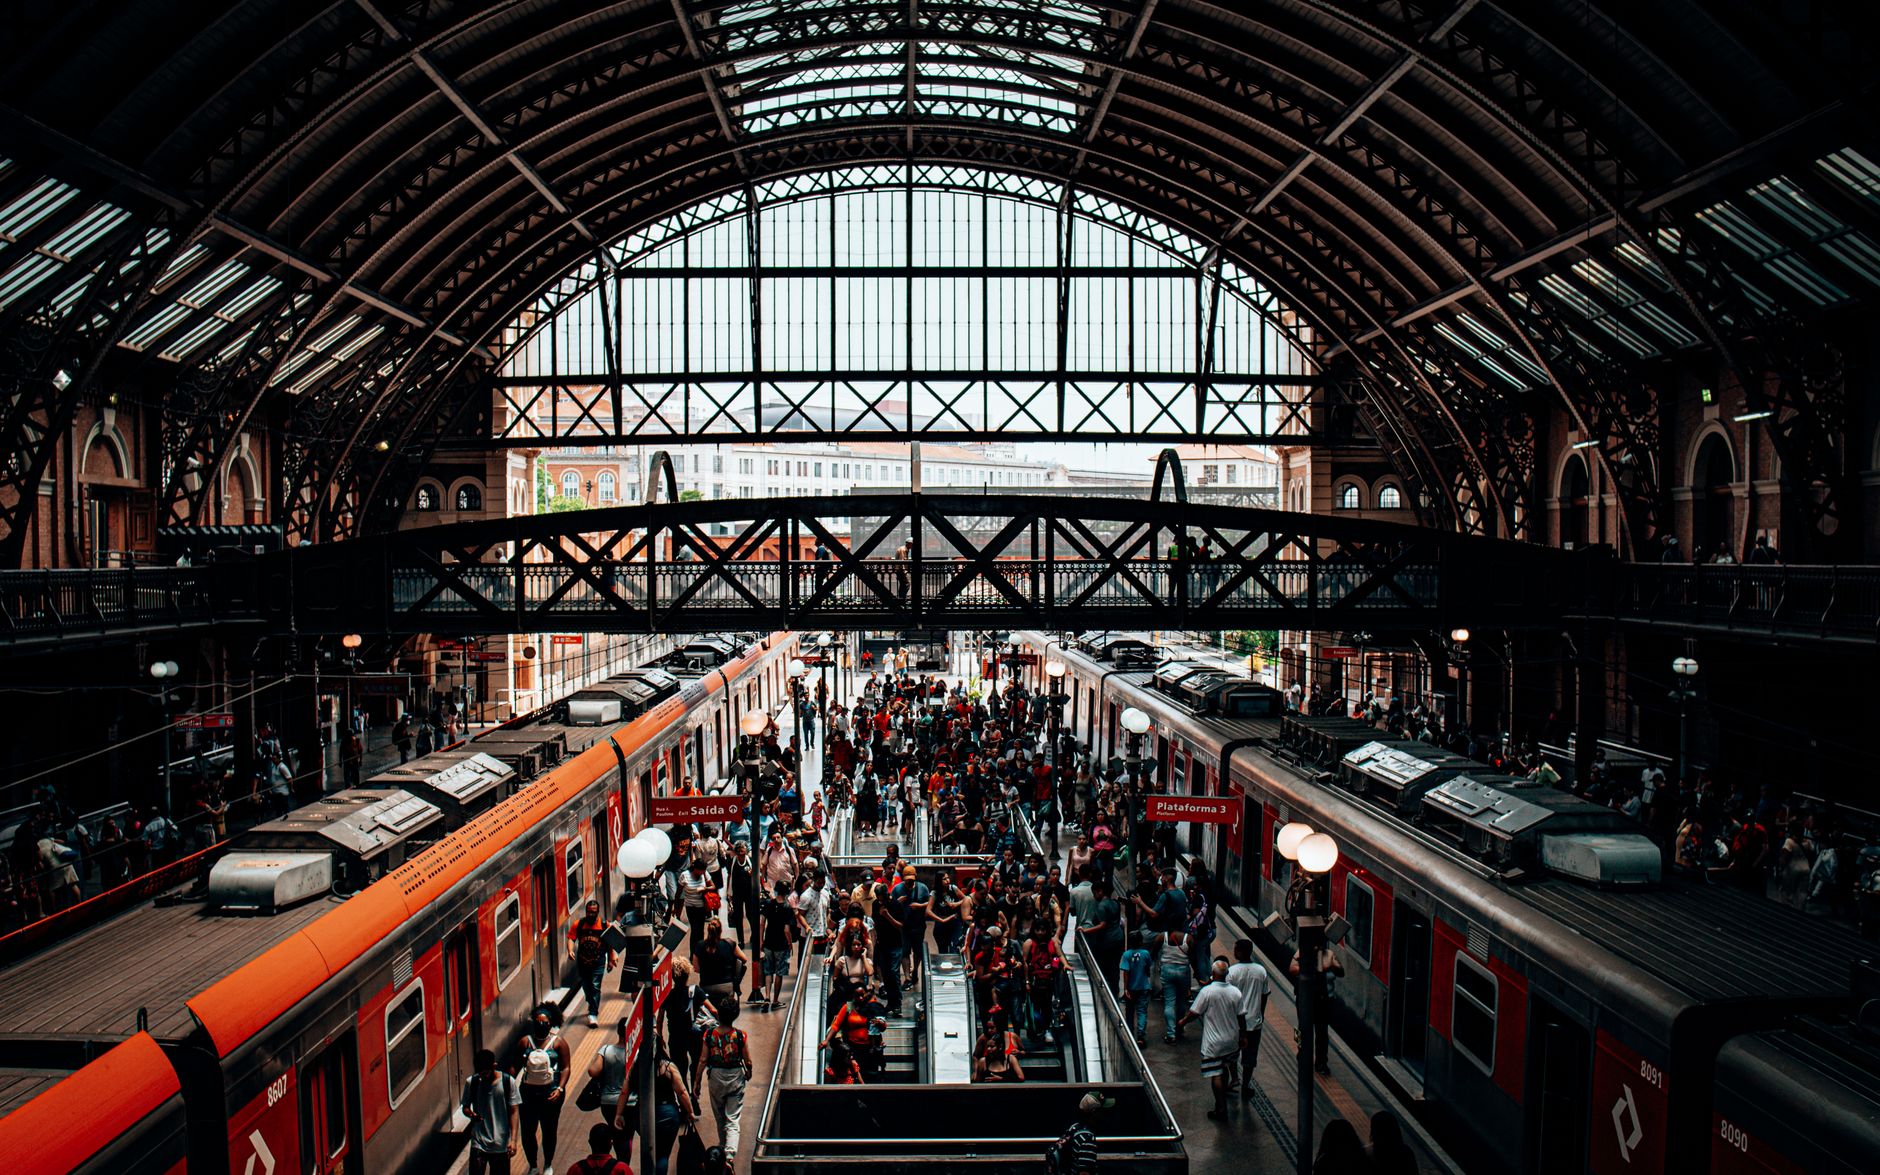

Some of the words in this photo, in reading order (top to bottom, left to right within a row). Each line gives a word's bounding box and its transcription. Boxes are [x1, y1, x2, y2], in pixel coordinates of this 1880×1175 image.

[690, 805, 725, 816] Saída
[1157, 802, 1217, 813] Plataforma
[1219, 805, 1227, 814] 3
[1640, 1060, 1663, 1089] 8091
[267, 1073, 288, 1107] 8607
[1720, 1119, 1748, 1152] 8090
